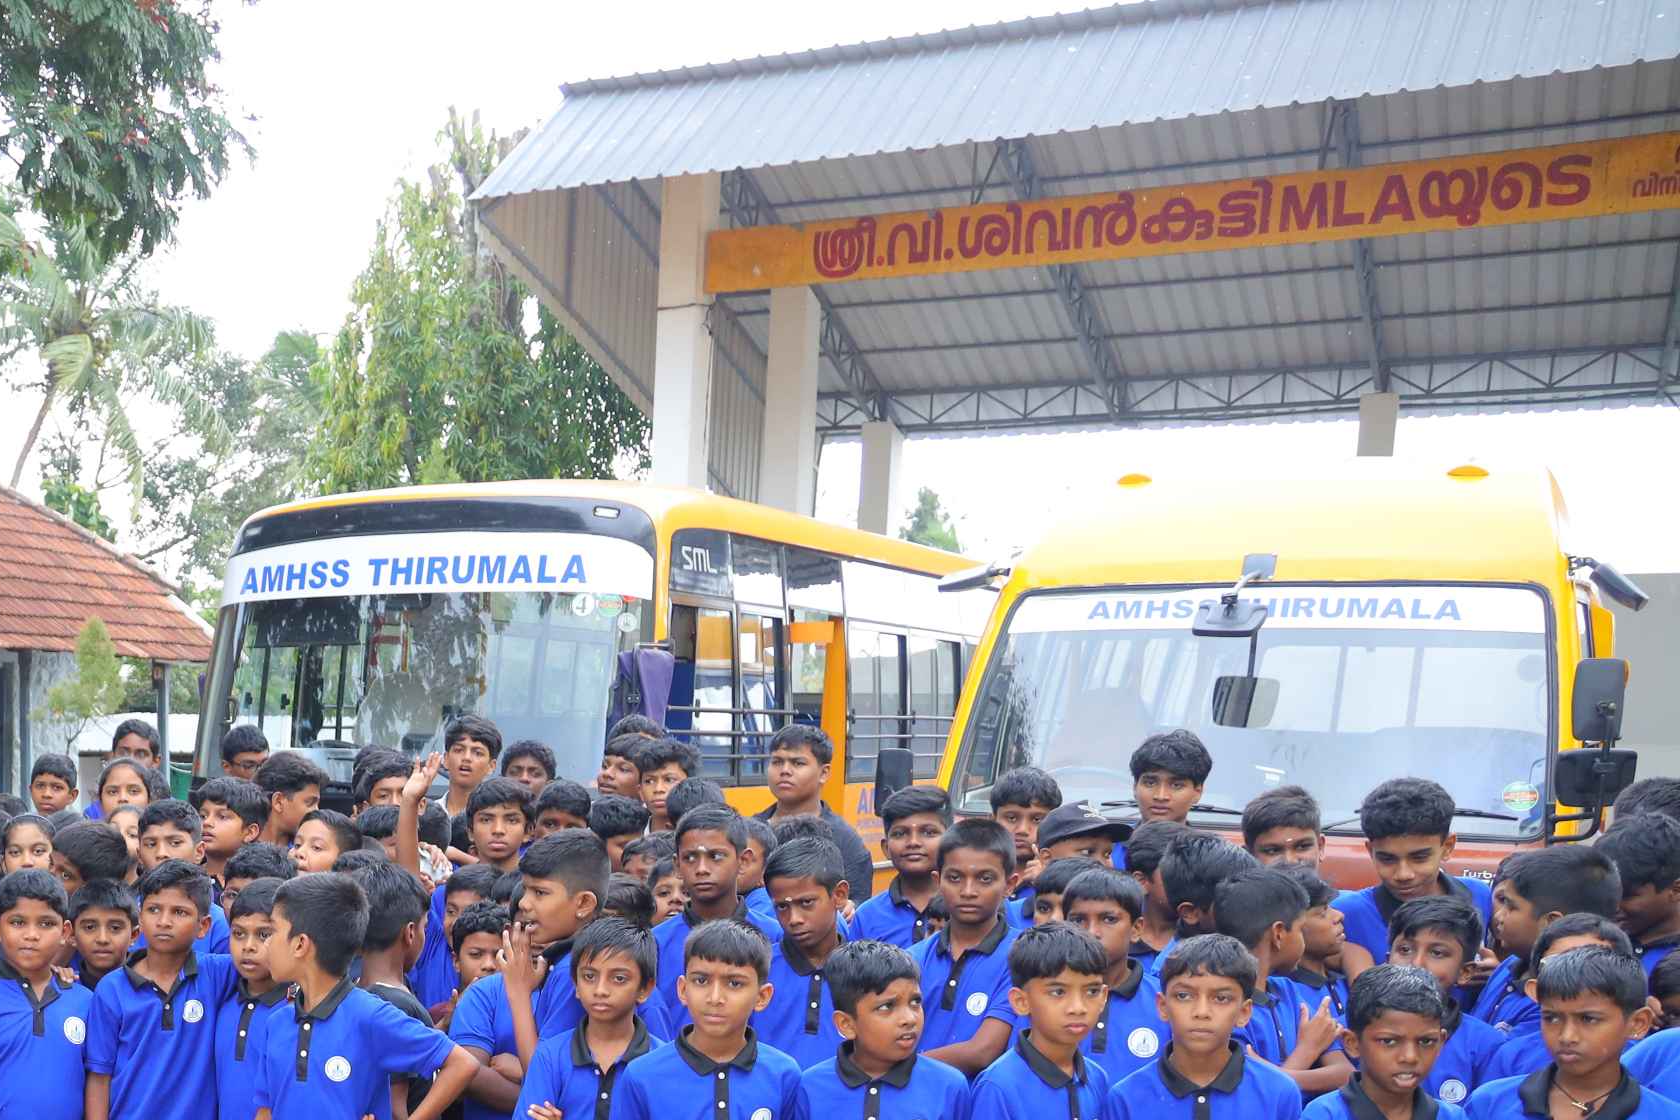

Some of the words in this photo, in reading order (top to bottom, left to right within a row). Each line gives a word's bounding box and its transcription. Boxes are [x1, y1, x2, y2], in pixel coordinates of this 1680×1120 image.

[681, 545, 718, 574] SML
[239, 559, 350, 595] AMHSS
[368, 554, 588, 586] THIRUMALA
[1087, 598, 1214, 621] AMHS
[1232, 597, 1462, 621] HIRUMALA
